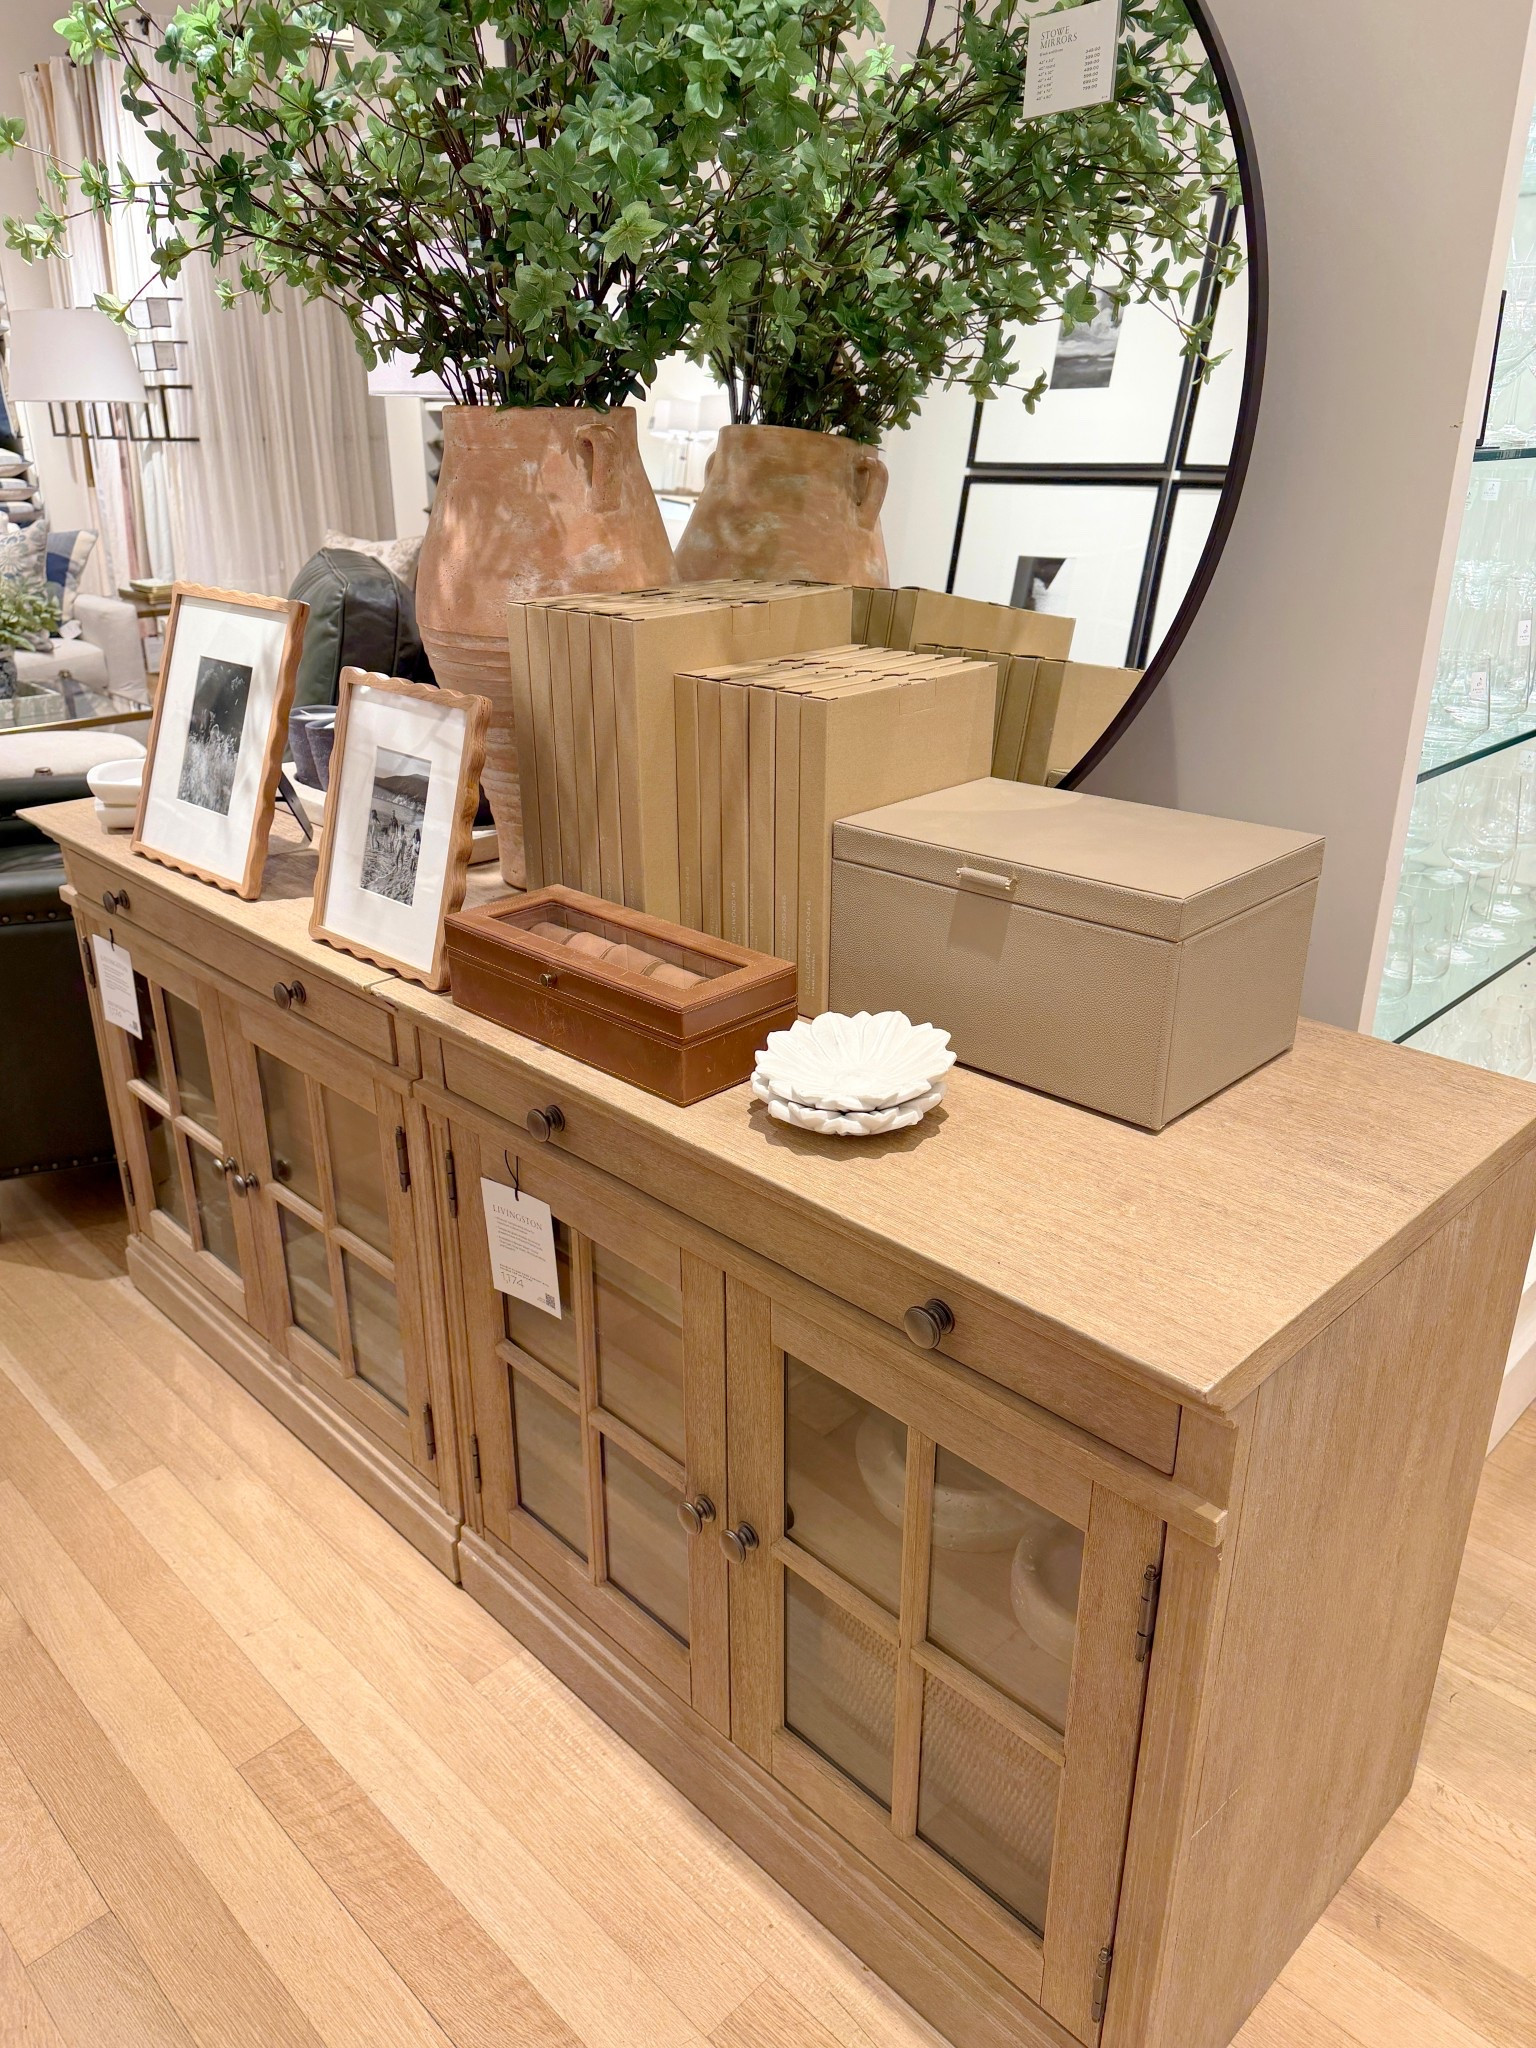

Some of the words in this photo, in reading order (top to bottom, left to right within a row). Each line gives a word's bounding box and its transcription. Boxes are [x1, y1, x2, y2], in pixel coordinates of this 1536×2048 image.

[1041, 25, 1070, 40] STOWE
[1040, 33, 1077, 49] MIRRORS
[492, 1204, 543, 1231] LIVINGSTON
